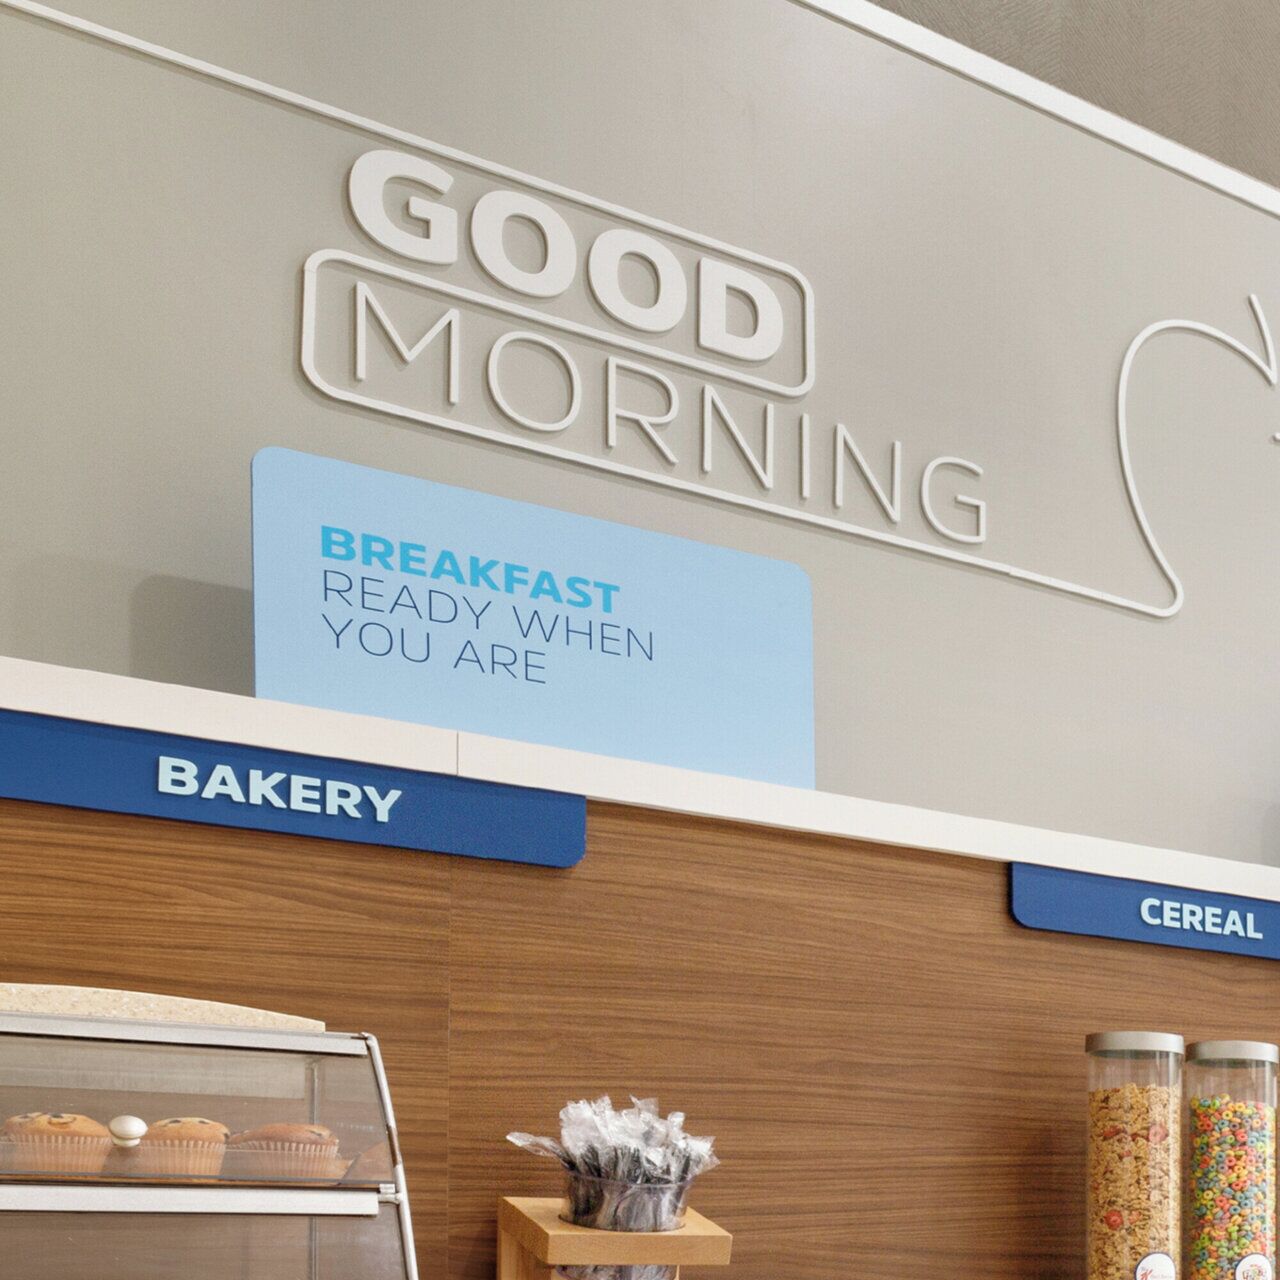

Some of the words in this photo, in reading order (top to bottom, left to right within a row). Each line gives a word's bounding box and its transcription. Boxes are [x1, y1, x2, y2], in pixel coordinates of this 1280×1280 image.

[348, 149, 785, 361] GOOD
[355, 281, 987, 544] MORNING
[320, 525, 621, 615] BREAKFAST
[321, 613, 431, 664] YOU
[452, 639, 548, 685] ARE
[322, 570, 492, 630] READY
[512, 609, 655, 662] WHEN
[157, 755, 403, 824] BAKERY
[1140, 897, 1264, 940] CEREAL
